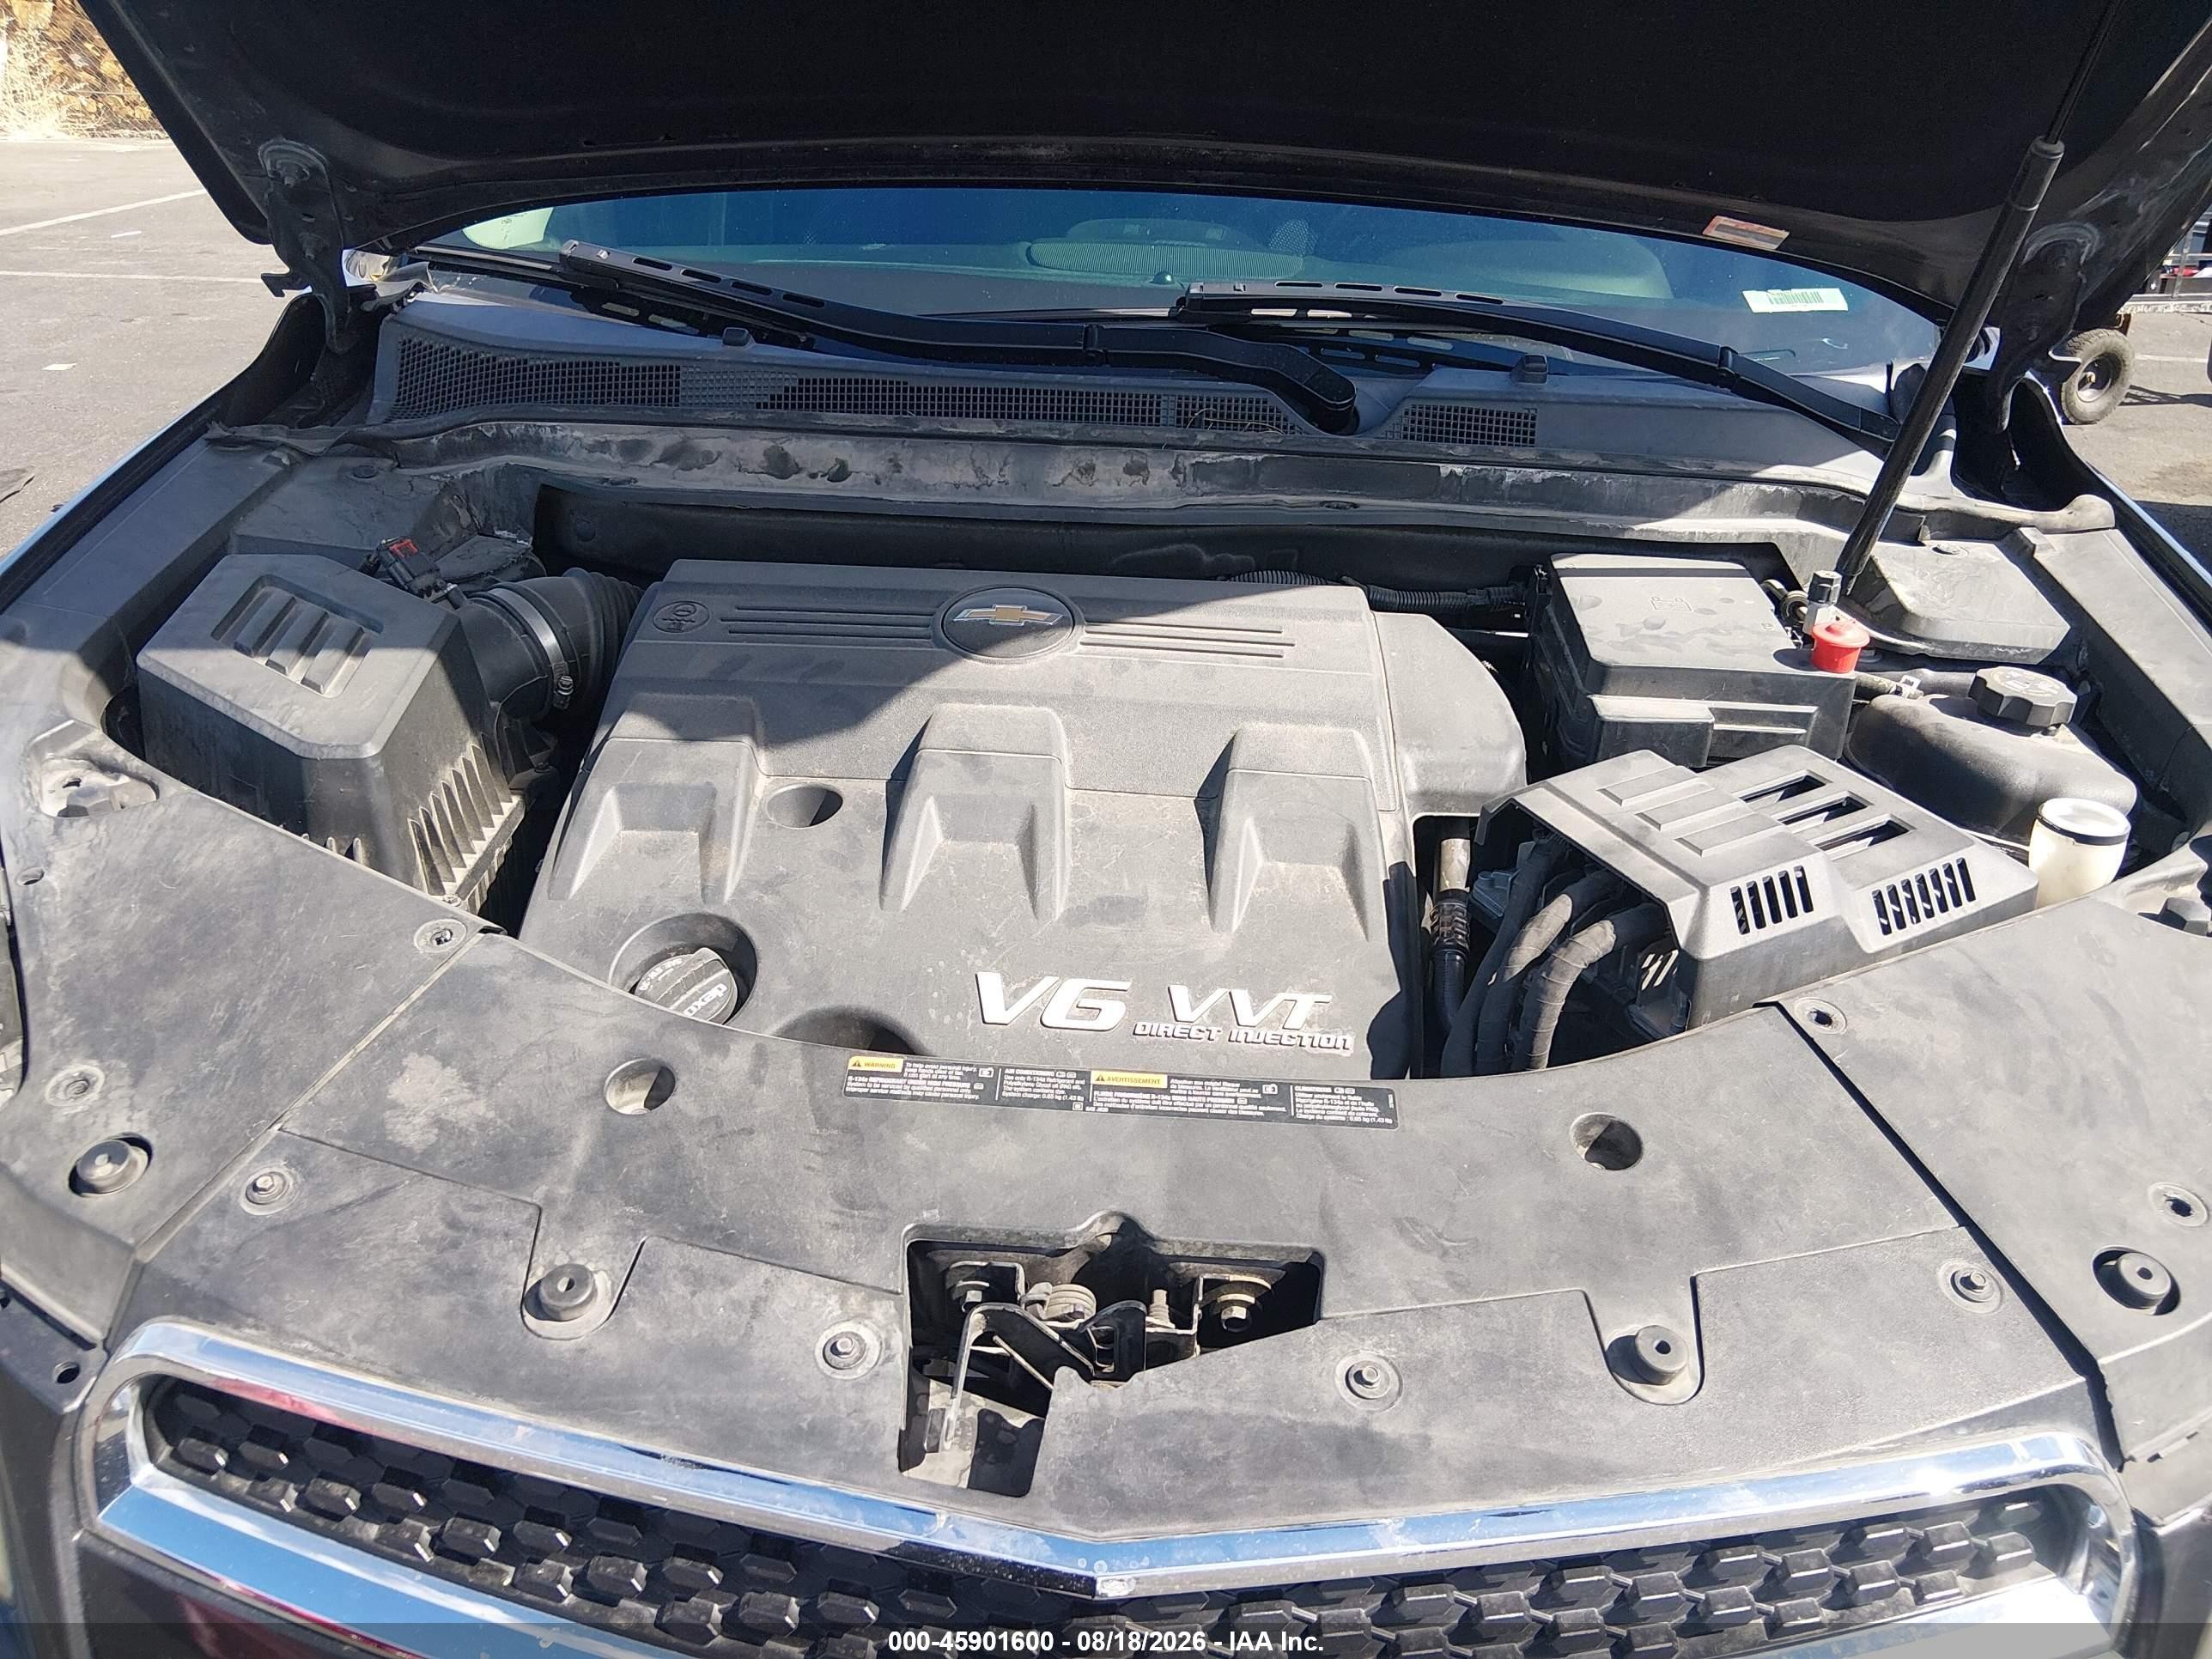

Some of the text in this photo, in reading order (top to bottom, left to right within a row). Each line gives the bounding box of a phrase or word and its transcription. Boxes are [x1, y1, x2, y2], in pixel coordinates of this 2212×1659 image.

[975, 971, 1133, 1031] V6
[1167, 984, 1334, 1030] VVT
[1133, 1021, 1354, 1051] DIRECT INJECTION
